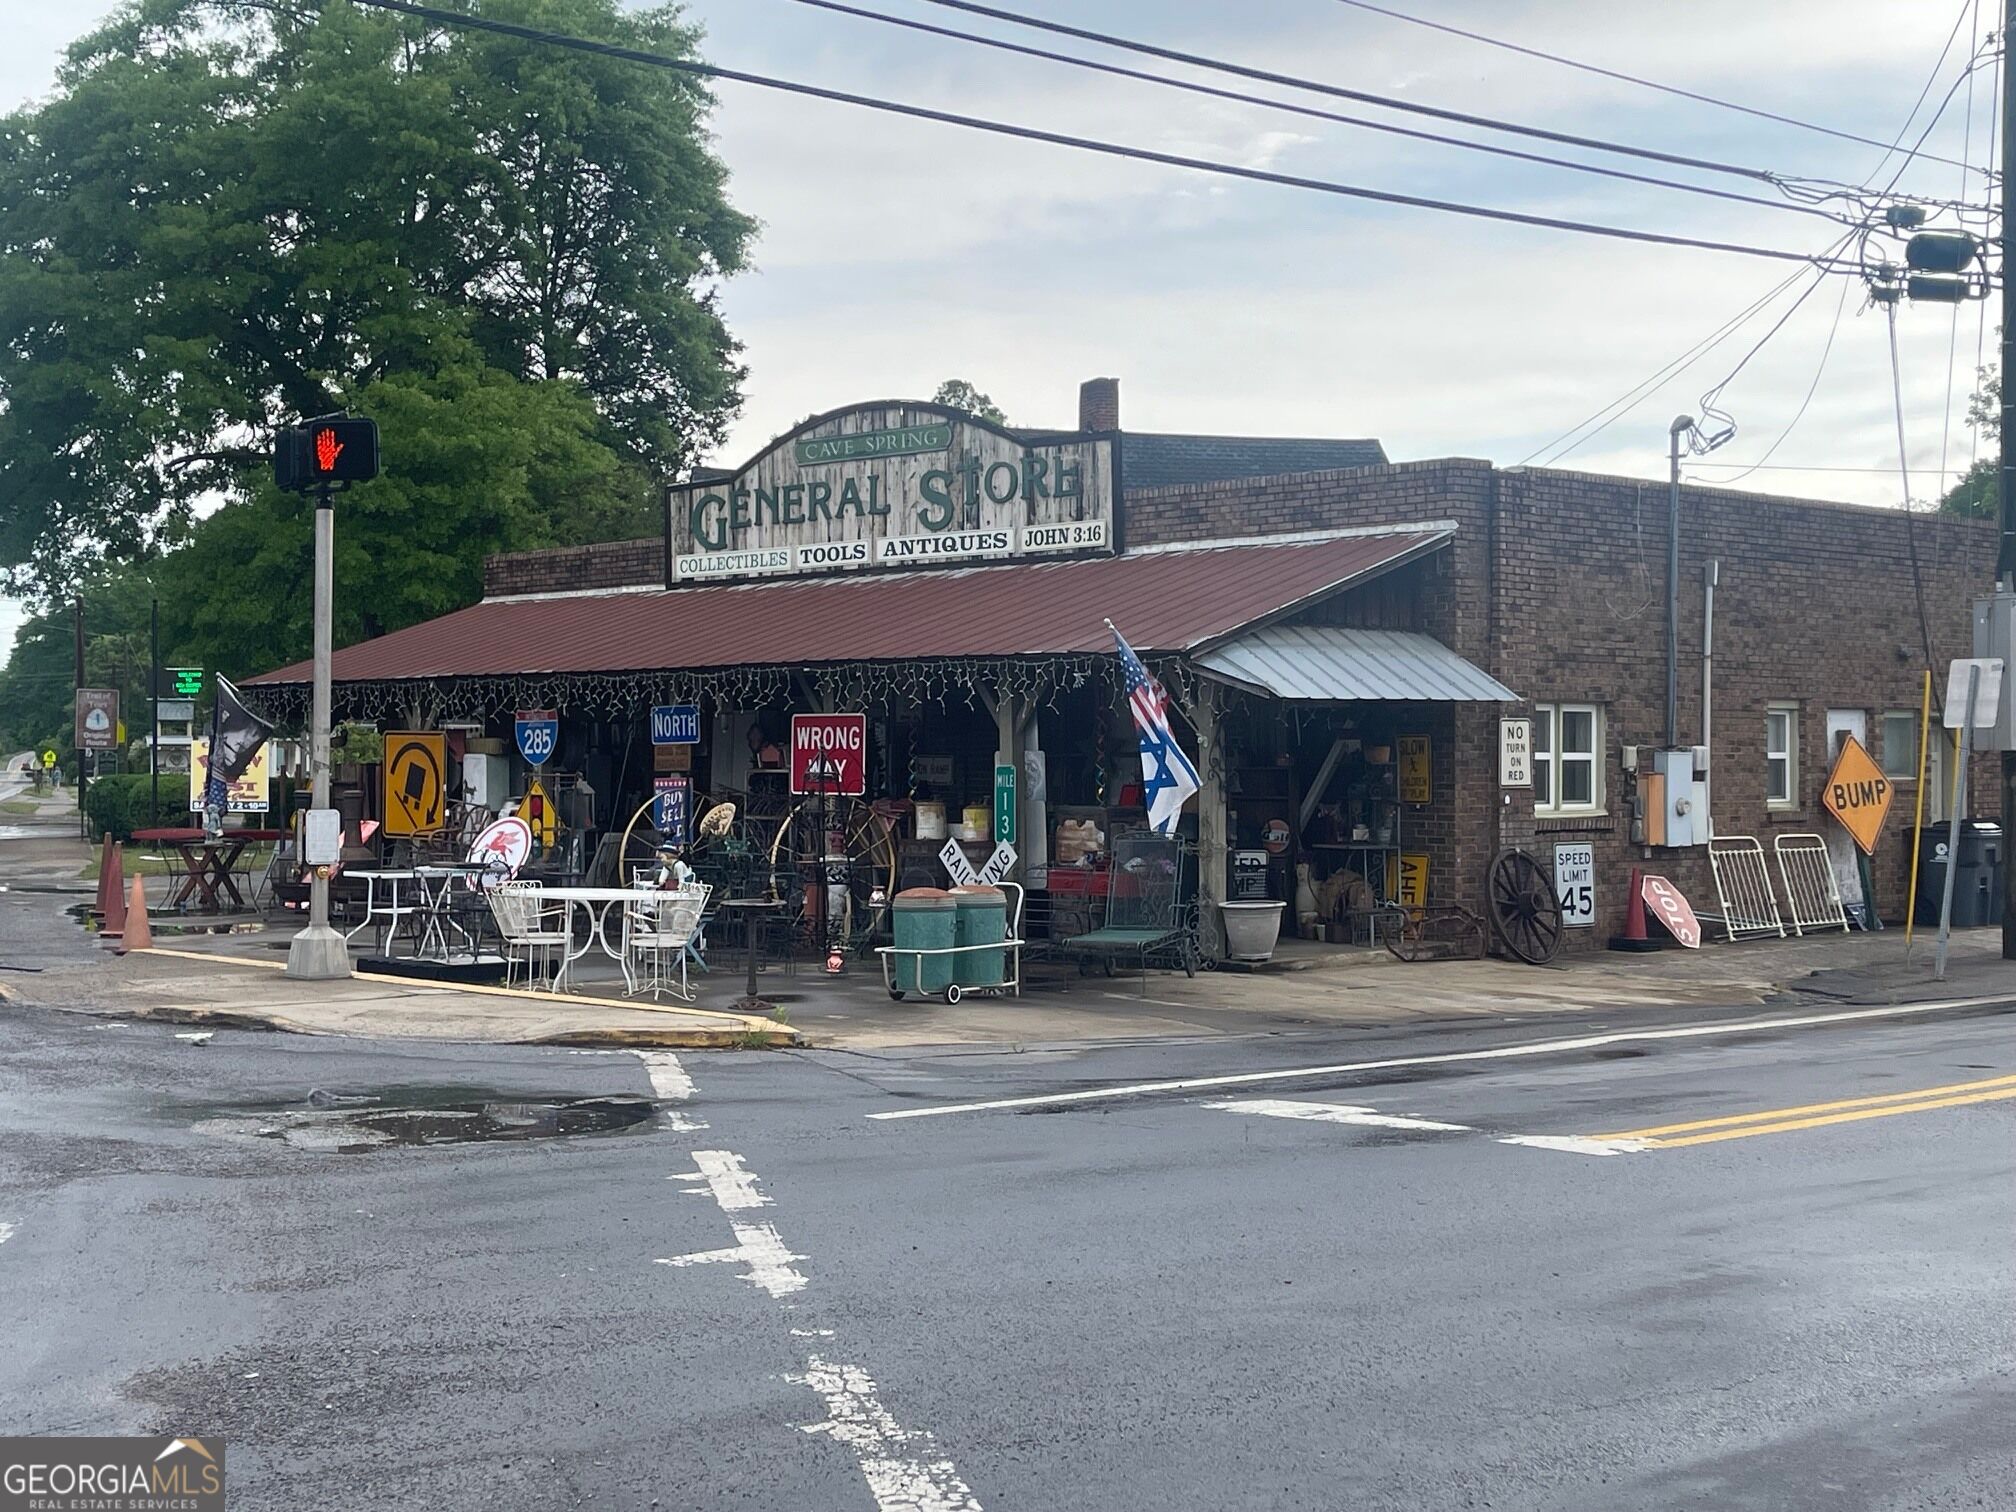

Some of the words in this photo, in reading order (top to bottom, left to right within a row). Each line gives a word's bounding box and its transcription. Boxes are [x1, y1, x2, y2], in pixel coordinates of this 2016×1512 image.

[805, 441, 854, 460] CAVE
[866, 429, 938, 451] SPRING
[691, 474, 891, 551] GENERAL
[917, 455, 1081, 531] STORE
[883, 532, 1008, 557] ANTIQUES
[1025, 527, 1069, 547] JOHN
[1073, 525, 1102, 544] 3:16
[679, 551, 788, 574] COLLECTIBLES
[800, 544, 866, 564] TOOLS
[83, 731, 111, 739] Original
[654, 713, 697, 738] NORTH
[1507, 726, 1523, 740] NO
[524, 728, 552, 755] 285
[797, 726, 860, 750] WRONG
[1506, 743, 1526, 753] TURN
[808, 759, 847, 783] WAY
[1510, 756, 1522, 767] ON
[997, 774, 1015, 788] MILE
[1508, 770, 1524, 781] RED
[664, 791, 683, 807] BUY
[1833, 779, 1887, 810] BUMP
[1558, 852, 1591, 866] SPEED
[1400, 860, 1418, 904] AHE
[1562, 869, 1588, 883] LIMIT
[1561, 886, 1592, 916] 45
[1651, 880, 1693, 942] STOP
